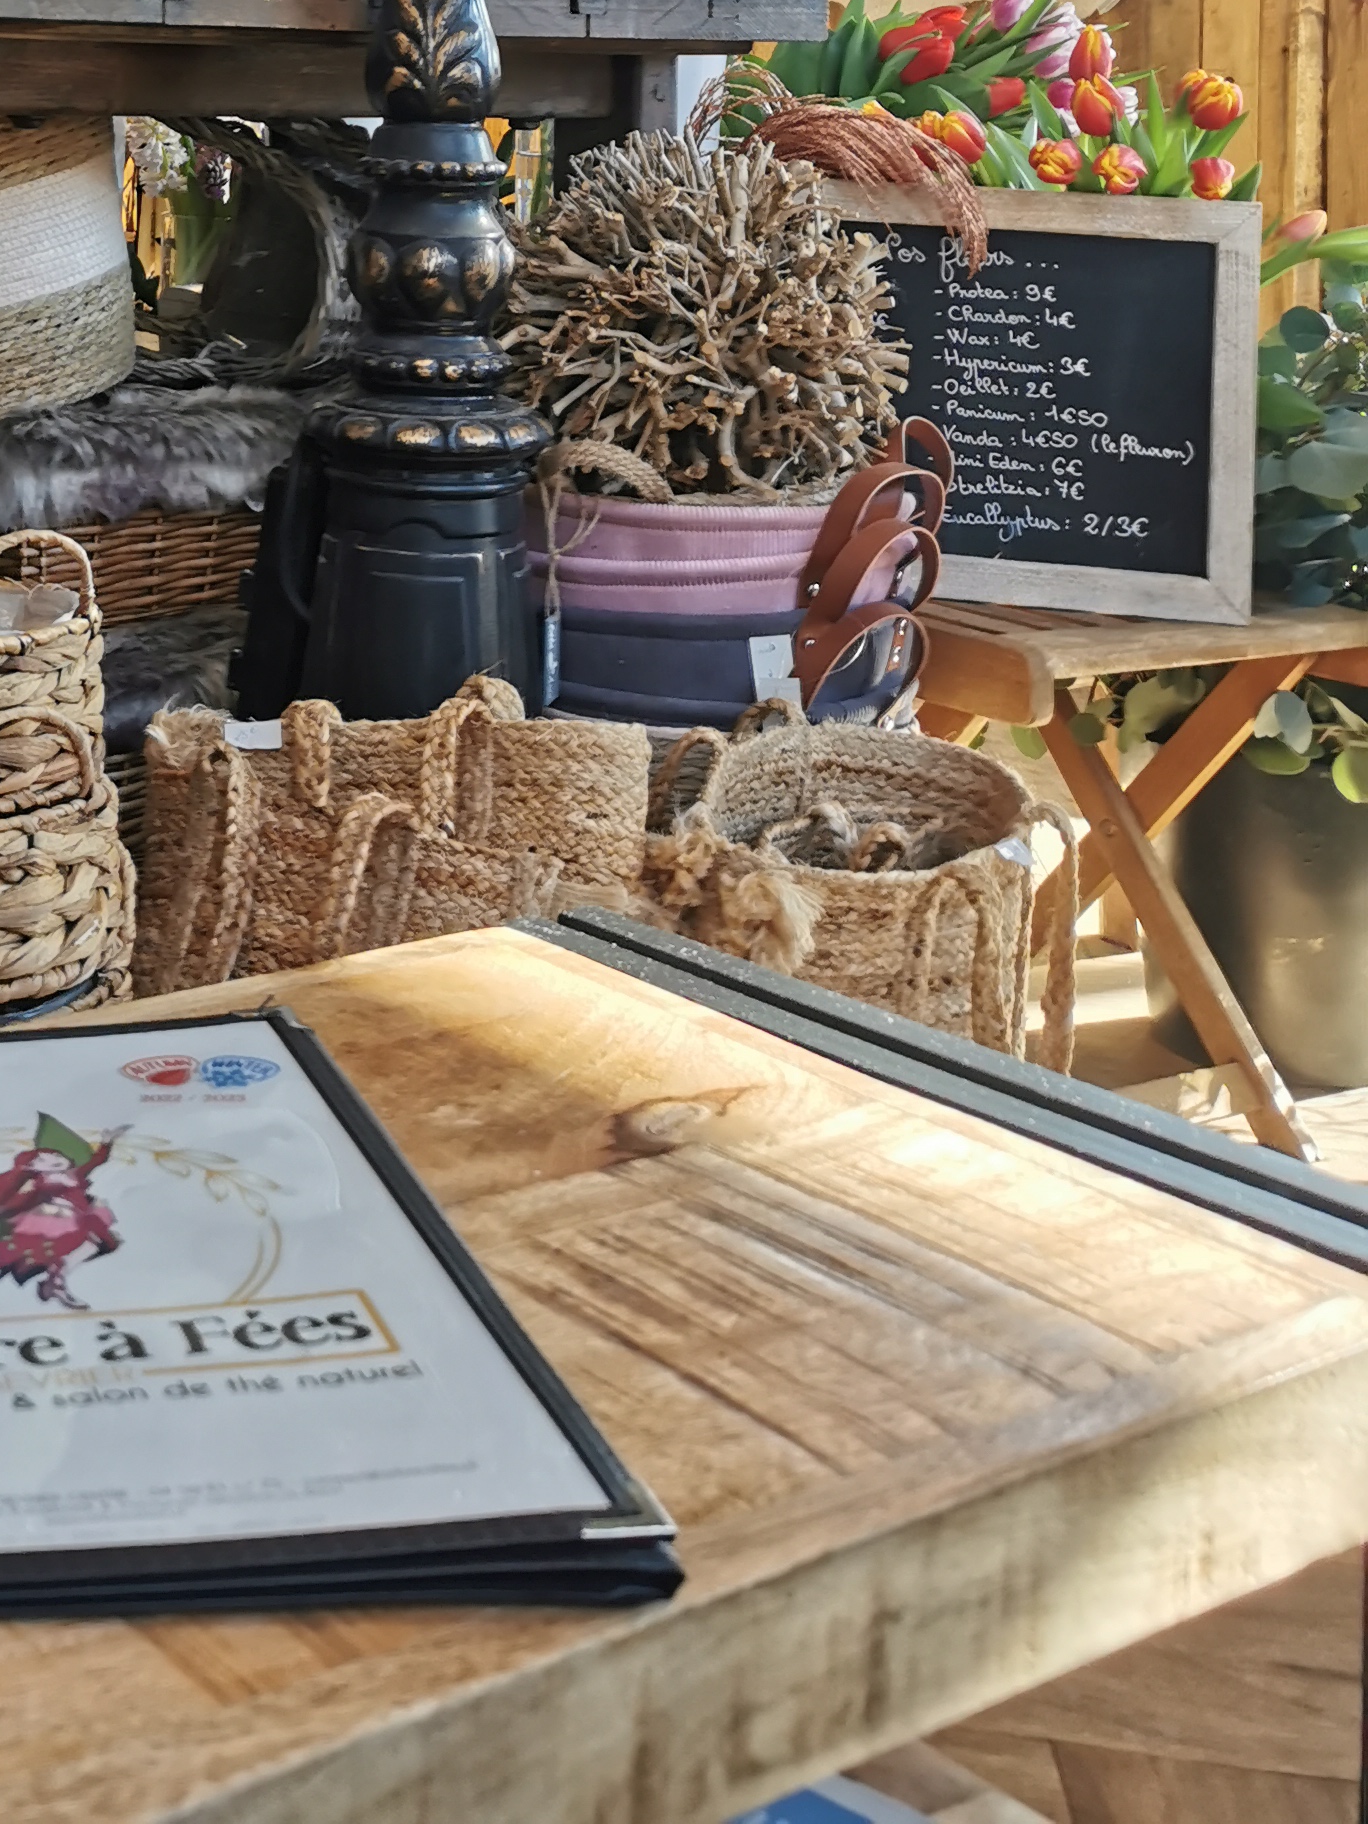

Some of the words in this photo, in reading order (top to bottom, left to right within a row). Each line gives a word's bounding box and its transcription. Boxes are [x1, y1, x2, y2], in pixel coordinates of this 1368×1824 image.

[1025, 284, 1058, 303] 9€
[1044, 308, 1077, 330] 4€
[1008, 329, 1041, 349] 4€
[1059, 356, 1092, 377] 3€
[1025, 381, 1057, 399] 2€
[1044, 404, 1109, 428] 1€50
[1021, 428, 1079, 449] 4€50
[951, 451, 985, 466] ini
[1051, 456, 1083, 477] 6€
[1053, 478, 1086, 501] 7€
[96, 1320, 152, 1363] à
[170, 1309, 373, 1355] Fées
[13, 1392, 37, 1409] &
[52, 1384, 150, 1408] salon
[163, 1378, 212, 1399] de
[296, 1359, 425, 1389] naturel
